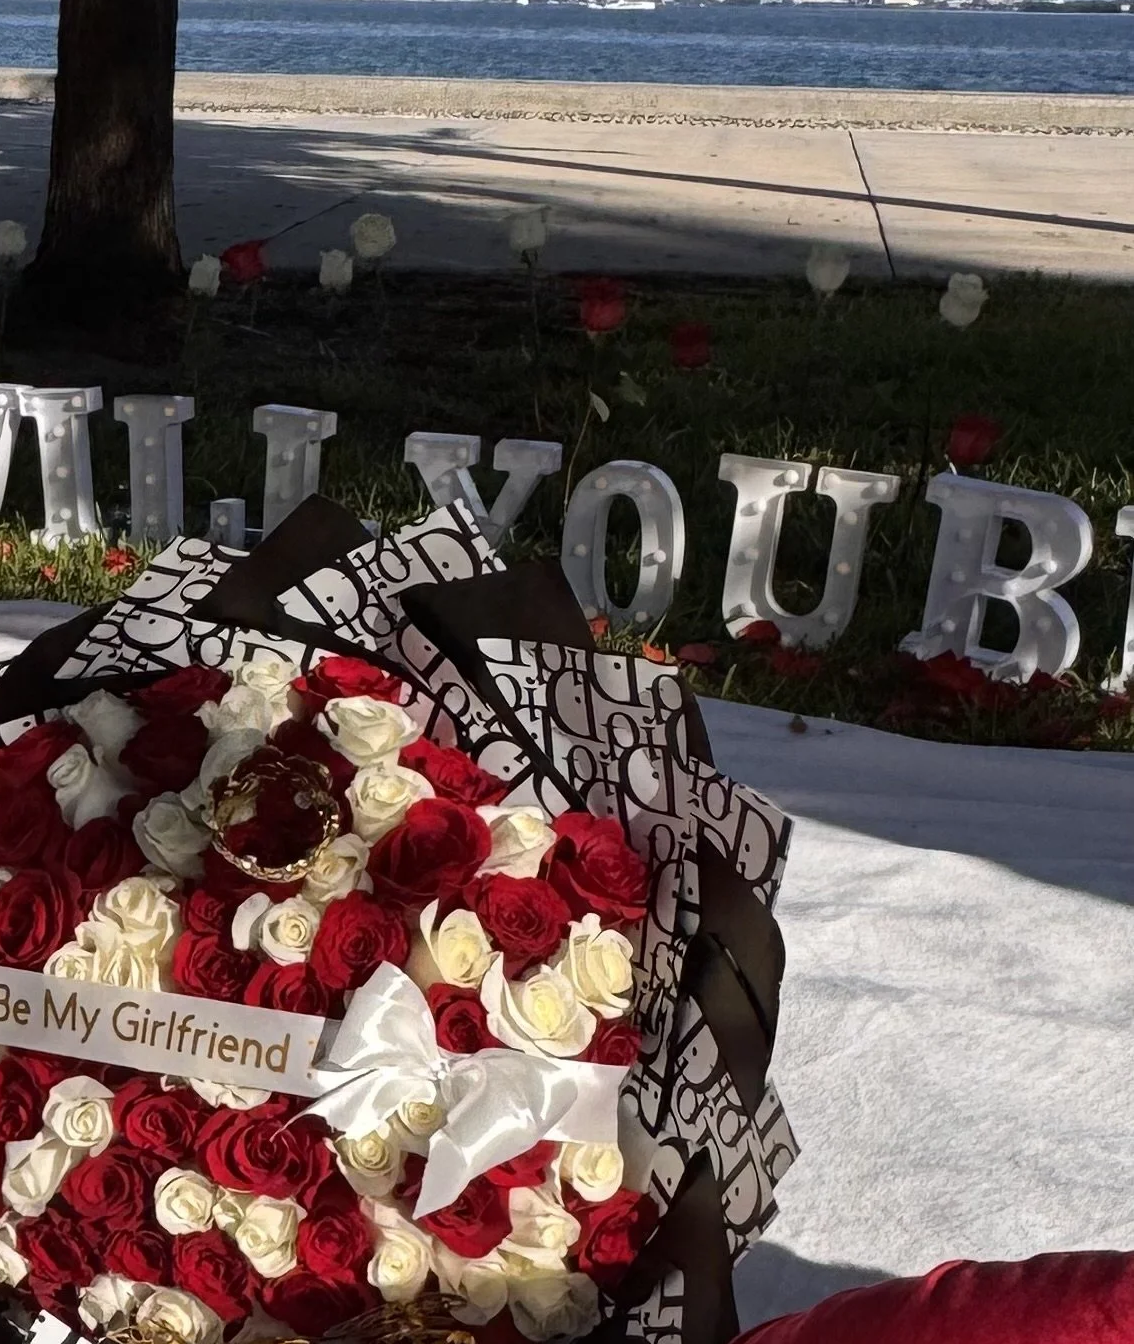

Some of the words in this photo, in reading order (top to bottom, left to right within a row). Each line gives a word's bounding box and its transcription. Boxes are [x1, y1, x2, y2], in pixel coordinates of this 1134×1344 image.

[404, 431, 900, 648] YOU
[899, 472, 1134, 694] B
[44, 990, 101, 1043] My
[112, 1001, 291, 1073] Girlfriend
